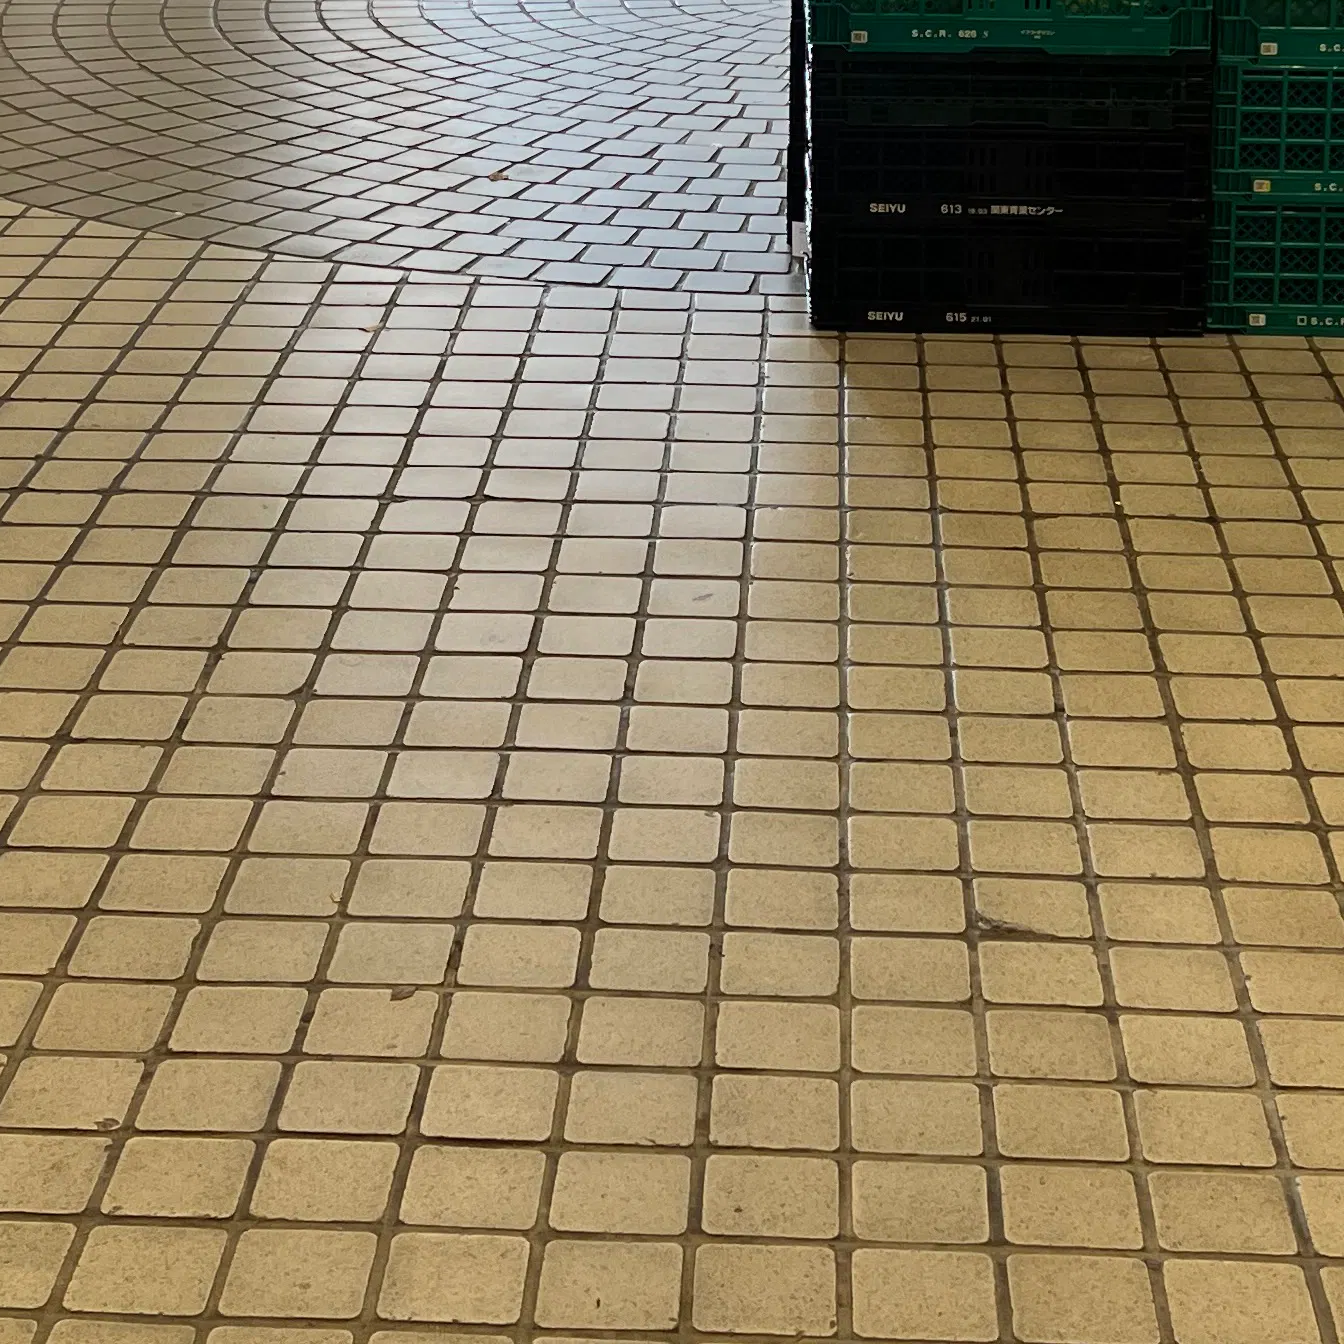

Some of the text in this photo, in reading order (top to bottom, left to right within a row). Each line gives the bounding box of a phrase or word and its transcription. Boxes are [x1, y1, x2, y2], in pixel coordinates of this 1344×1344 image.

[869, 203, 906, 213] SEIYU
[940, 204, 963, 214] 613
[867, 311, 904, 322] SEIYU
[946, 312, 968, 323] 615
